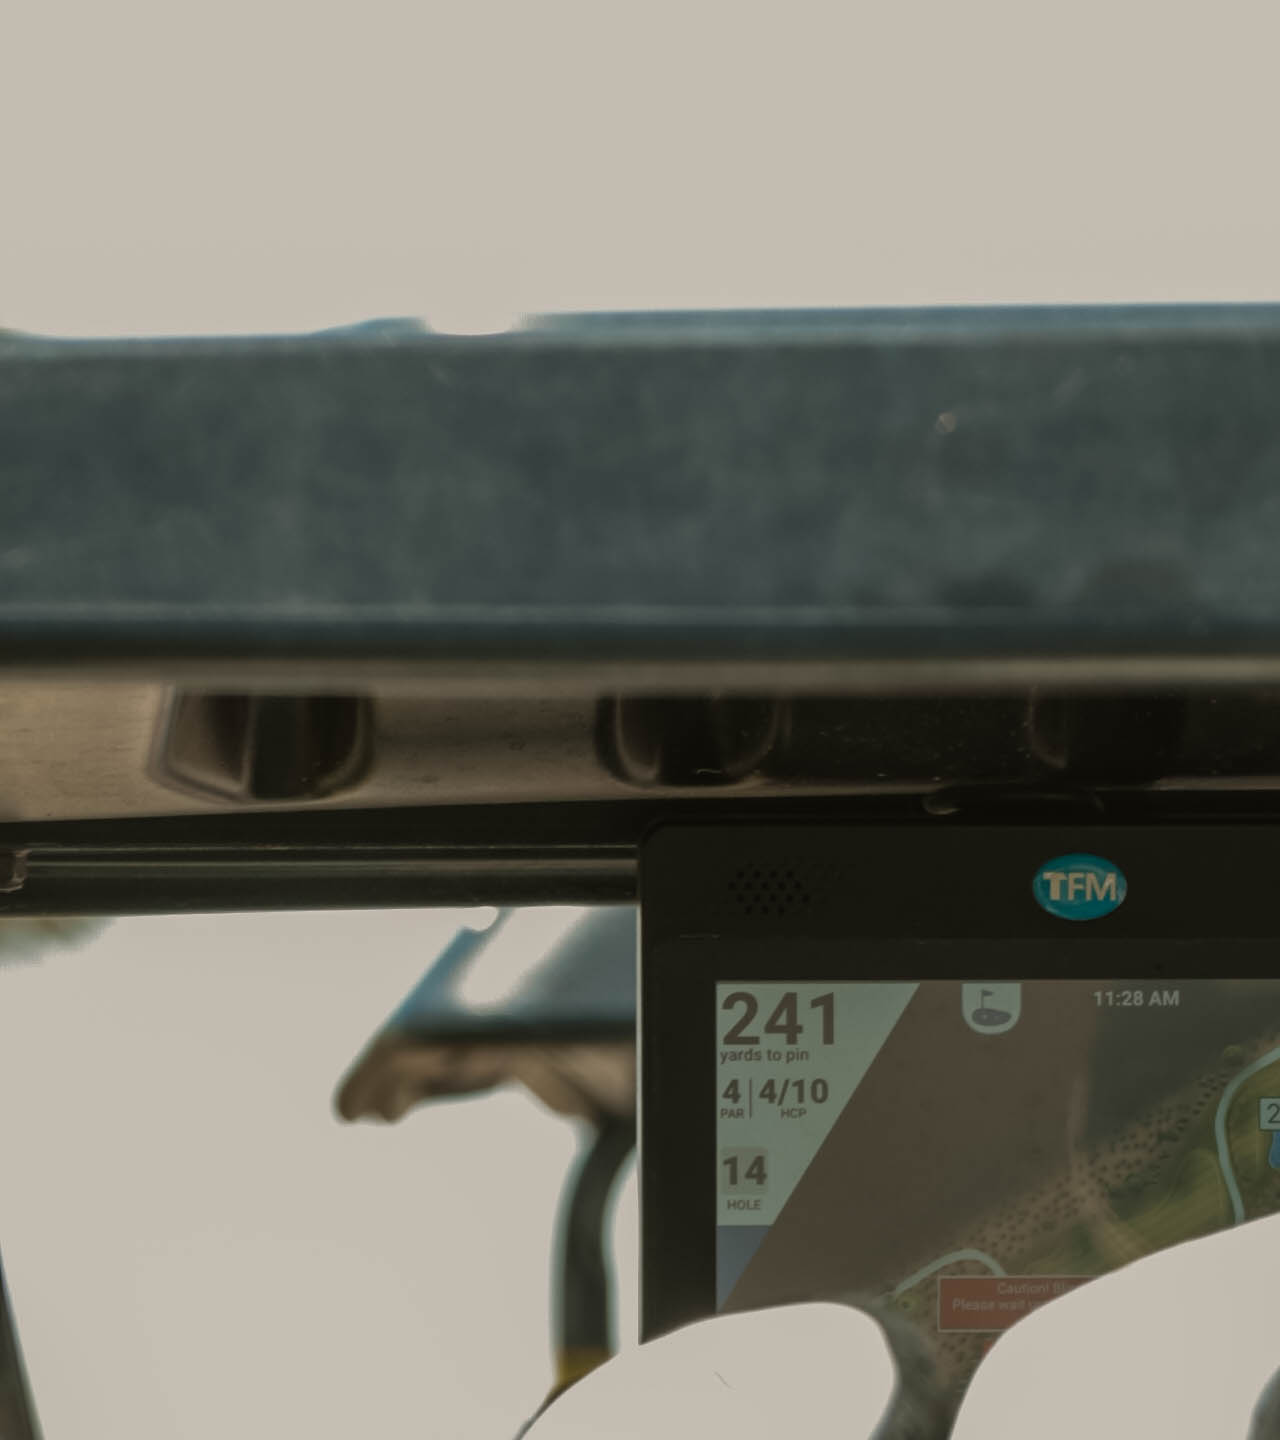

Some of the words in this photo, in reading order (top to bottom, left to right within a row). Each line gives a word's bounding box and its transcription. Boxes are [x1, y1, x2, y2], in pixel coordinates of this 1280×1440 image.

[1042, 871, 1118, 902] TFM
[1093, 990, 1145, 1007] 11:28
[1148, 990, 1180, 1007] AM
[721, 991, 835, 1046] 241
[719, 1048, 762, 1065] yards
[767, 1049, 782, 1062] to
[786, 1048, 809, 1064] pin
[722, 1078, 742, 1105] 4
[759, 1078, 830, 1107] 4/10
[719, 1108, 745, 1120] PAR
[780, 1108, 808, 1120] HCP
[722, 1155, 768, 1186] 14
[726, 1199, 761, 1211] HOLE
